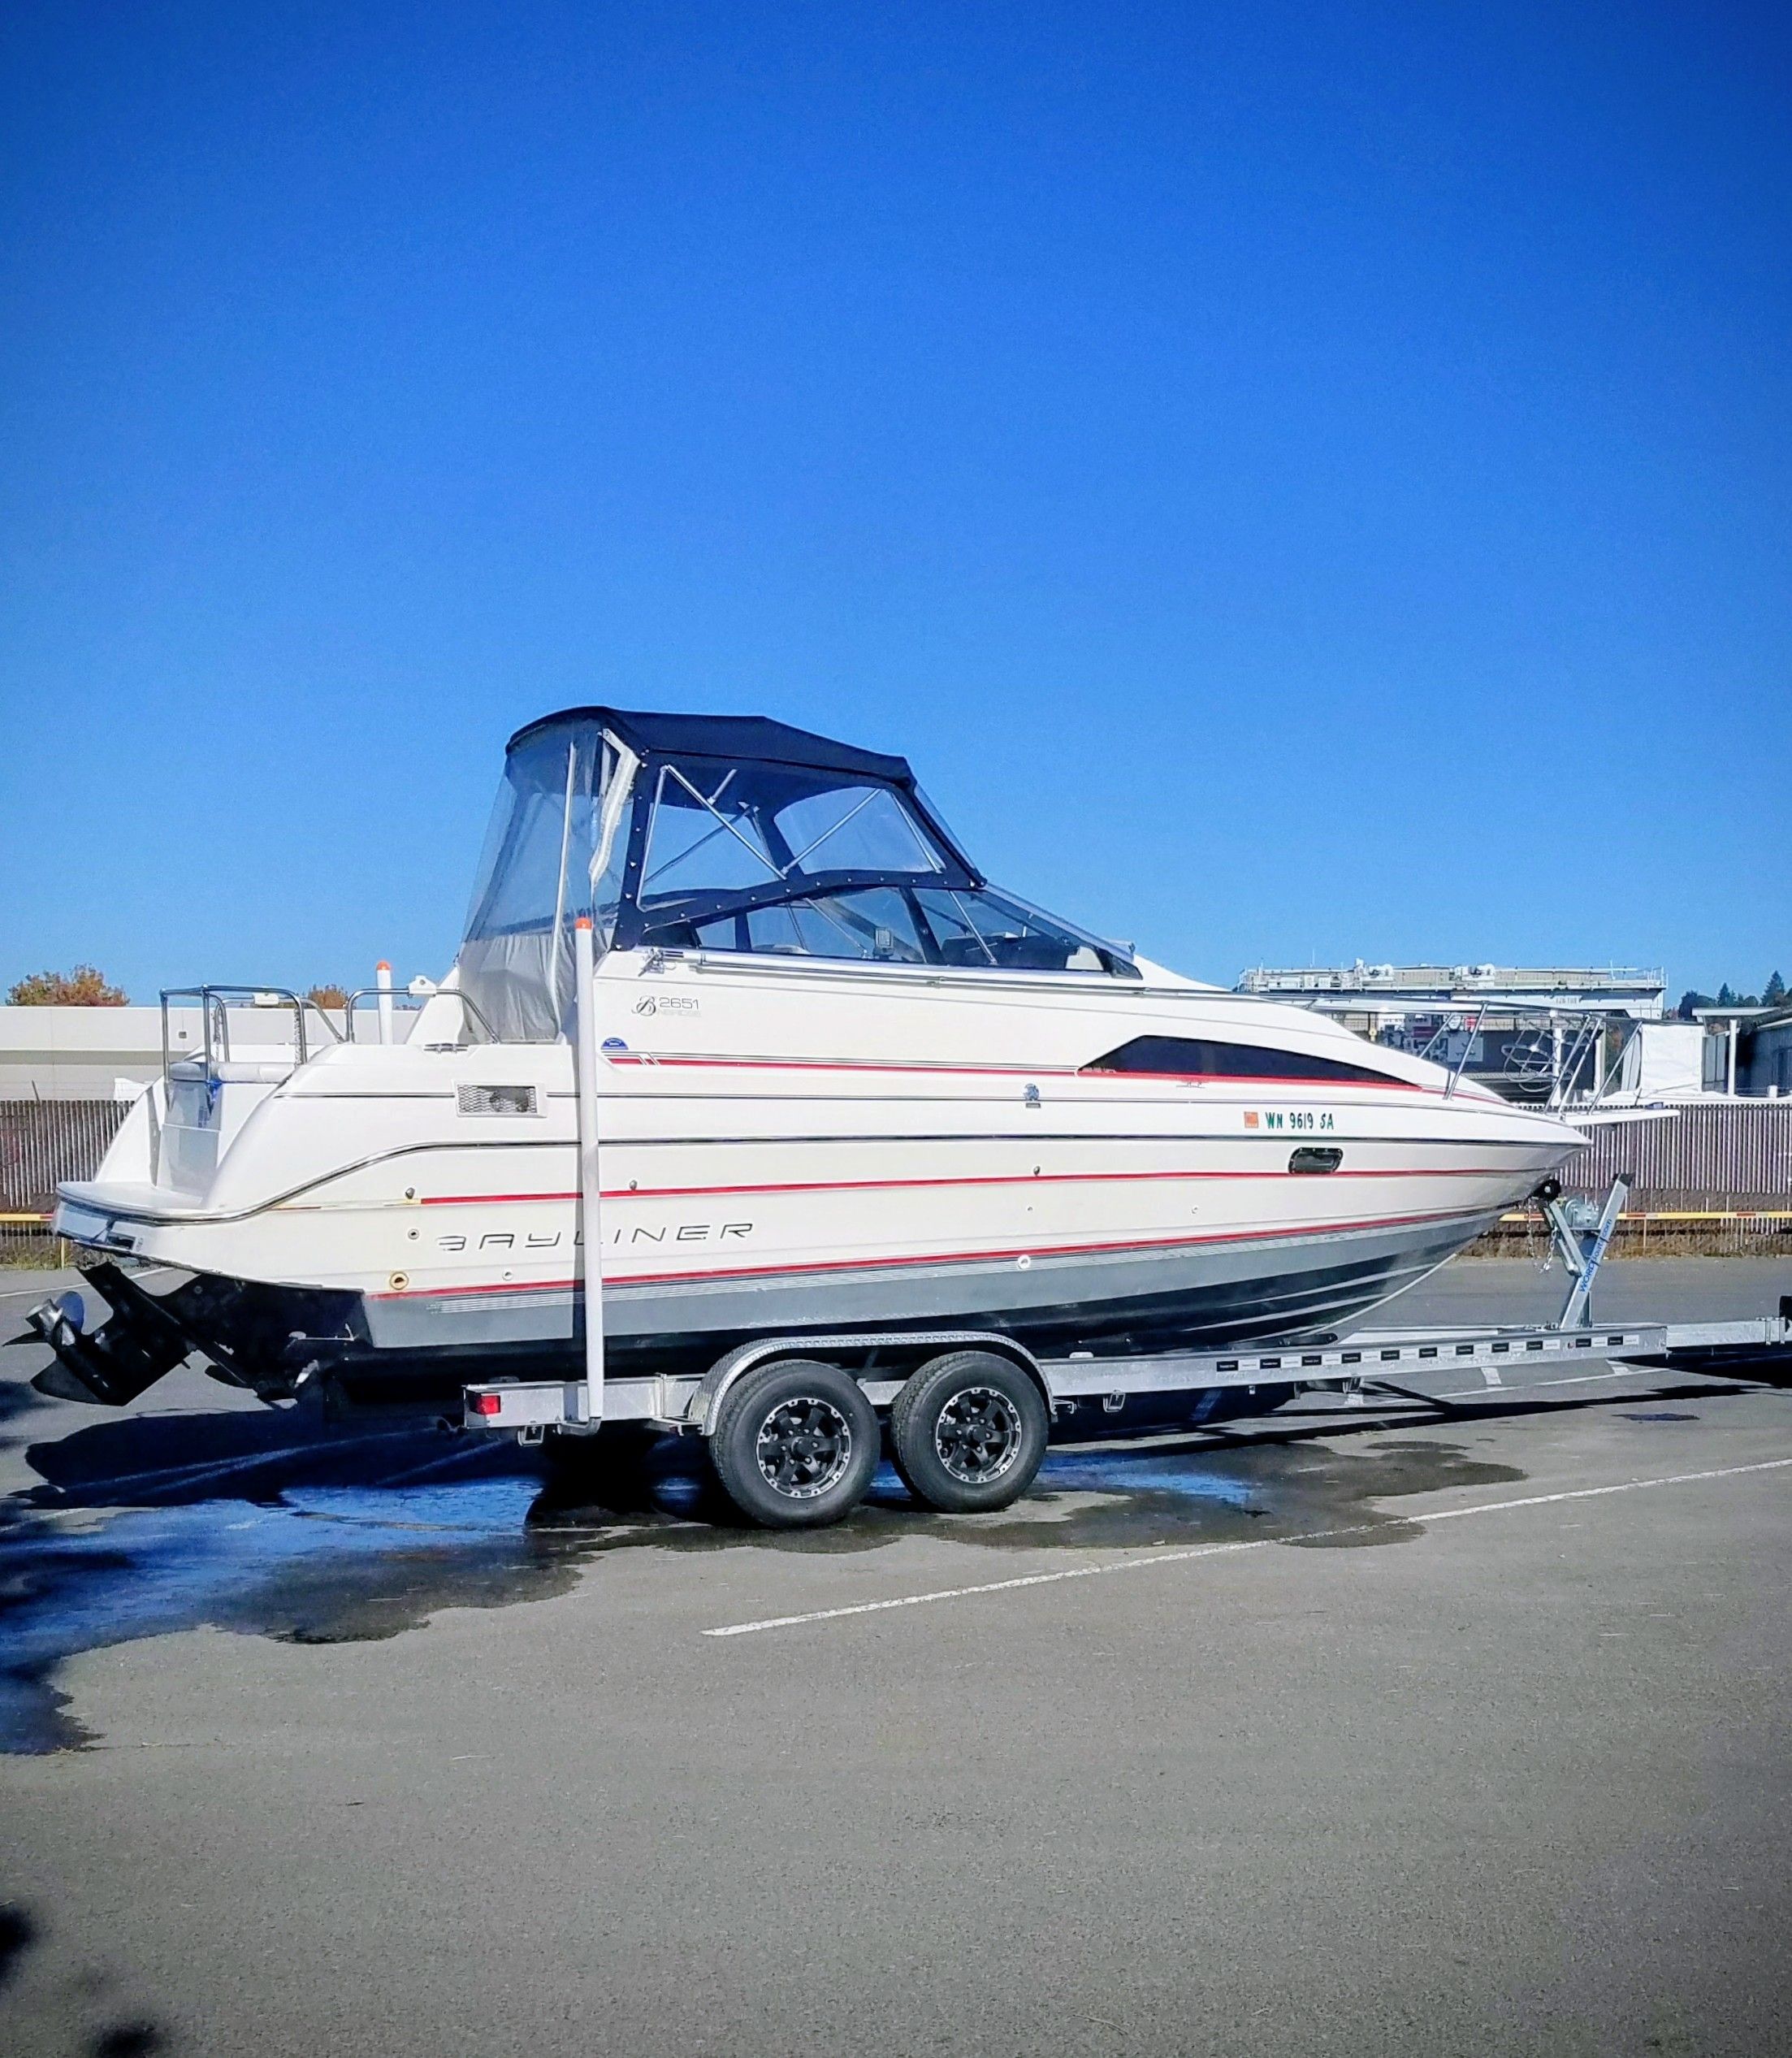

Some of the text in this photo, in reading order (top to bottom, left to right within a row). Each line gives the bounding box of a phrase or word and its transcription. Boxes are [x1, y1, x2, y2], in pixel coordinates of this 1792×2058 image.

[659, 997, 699, 1010] 2651
[1266, 1111, 1334, 1130] WN 9619 SA
